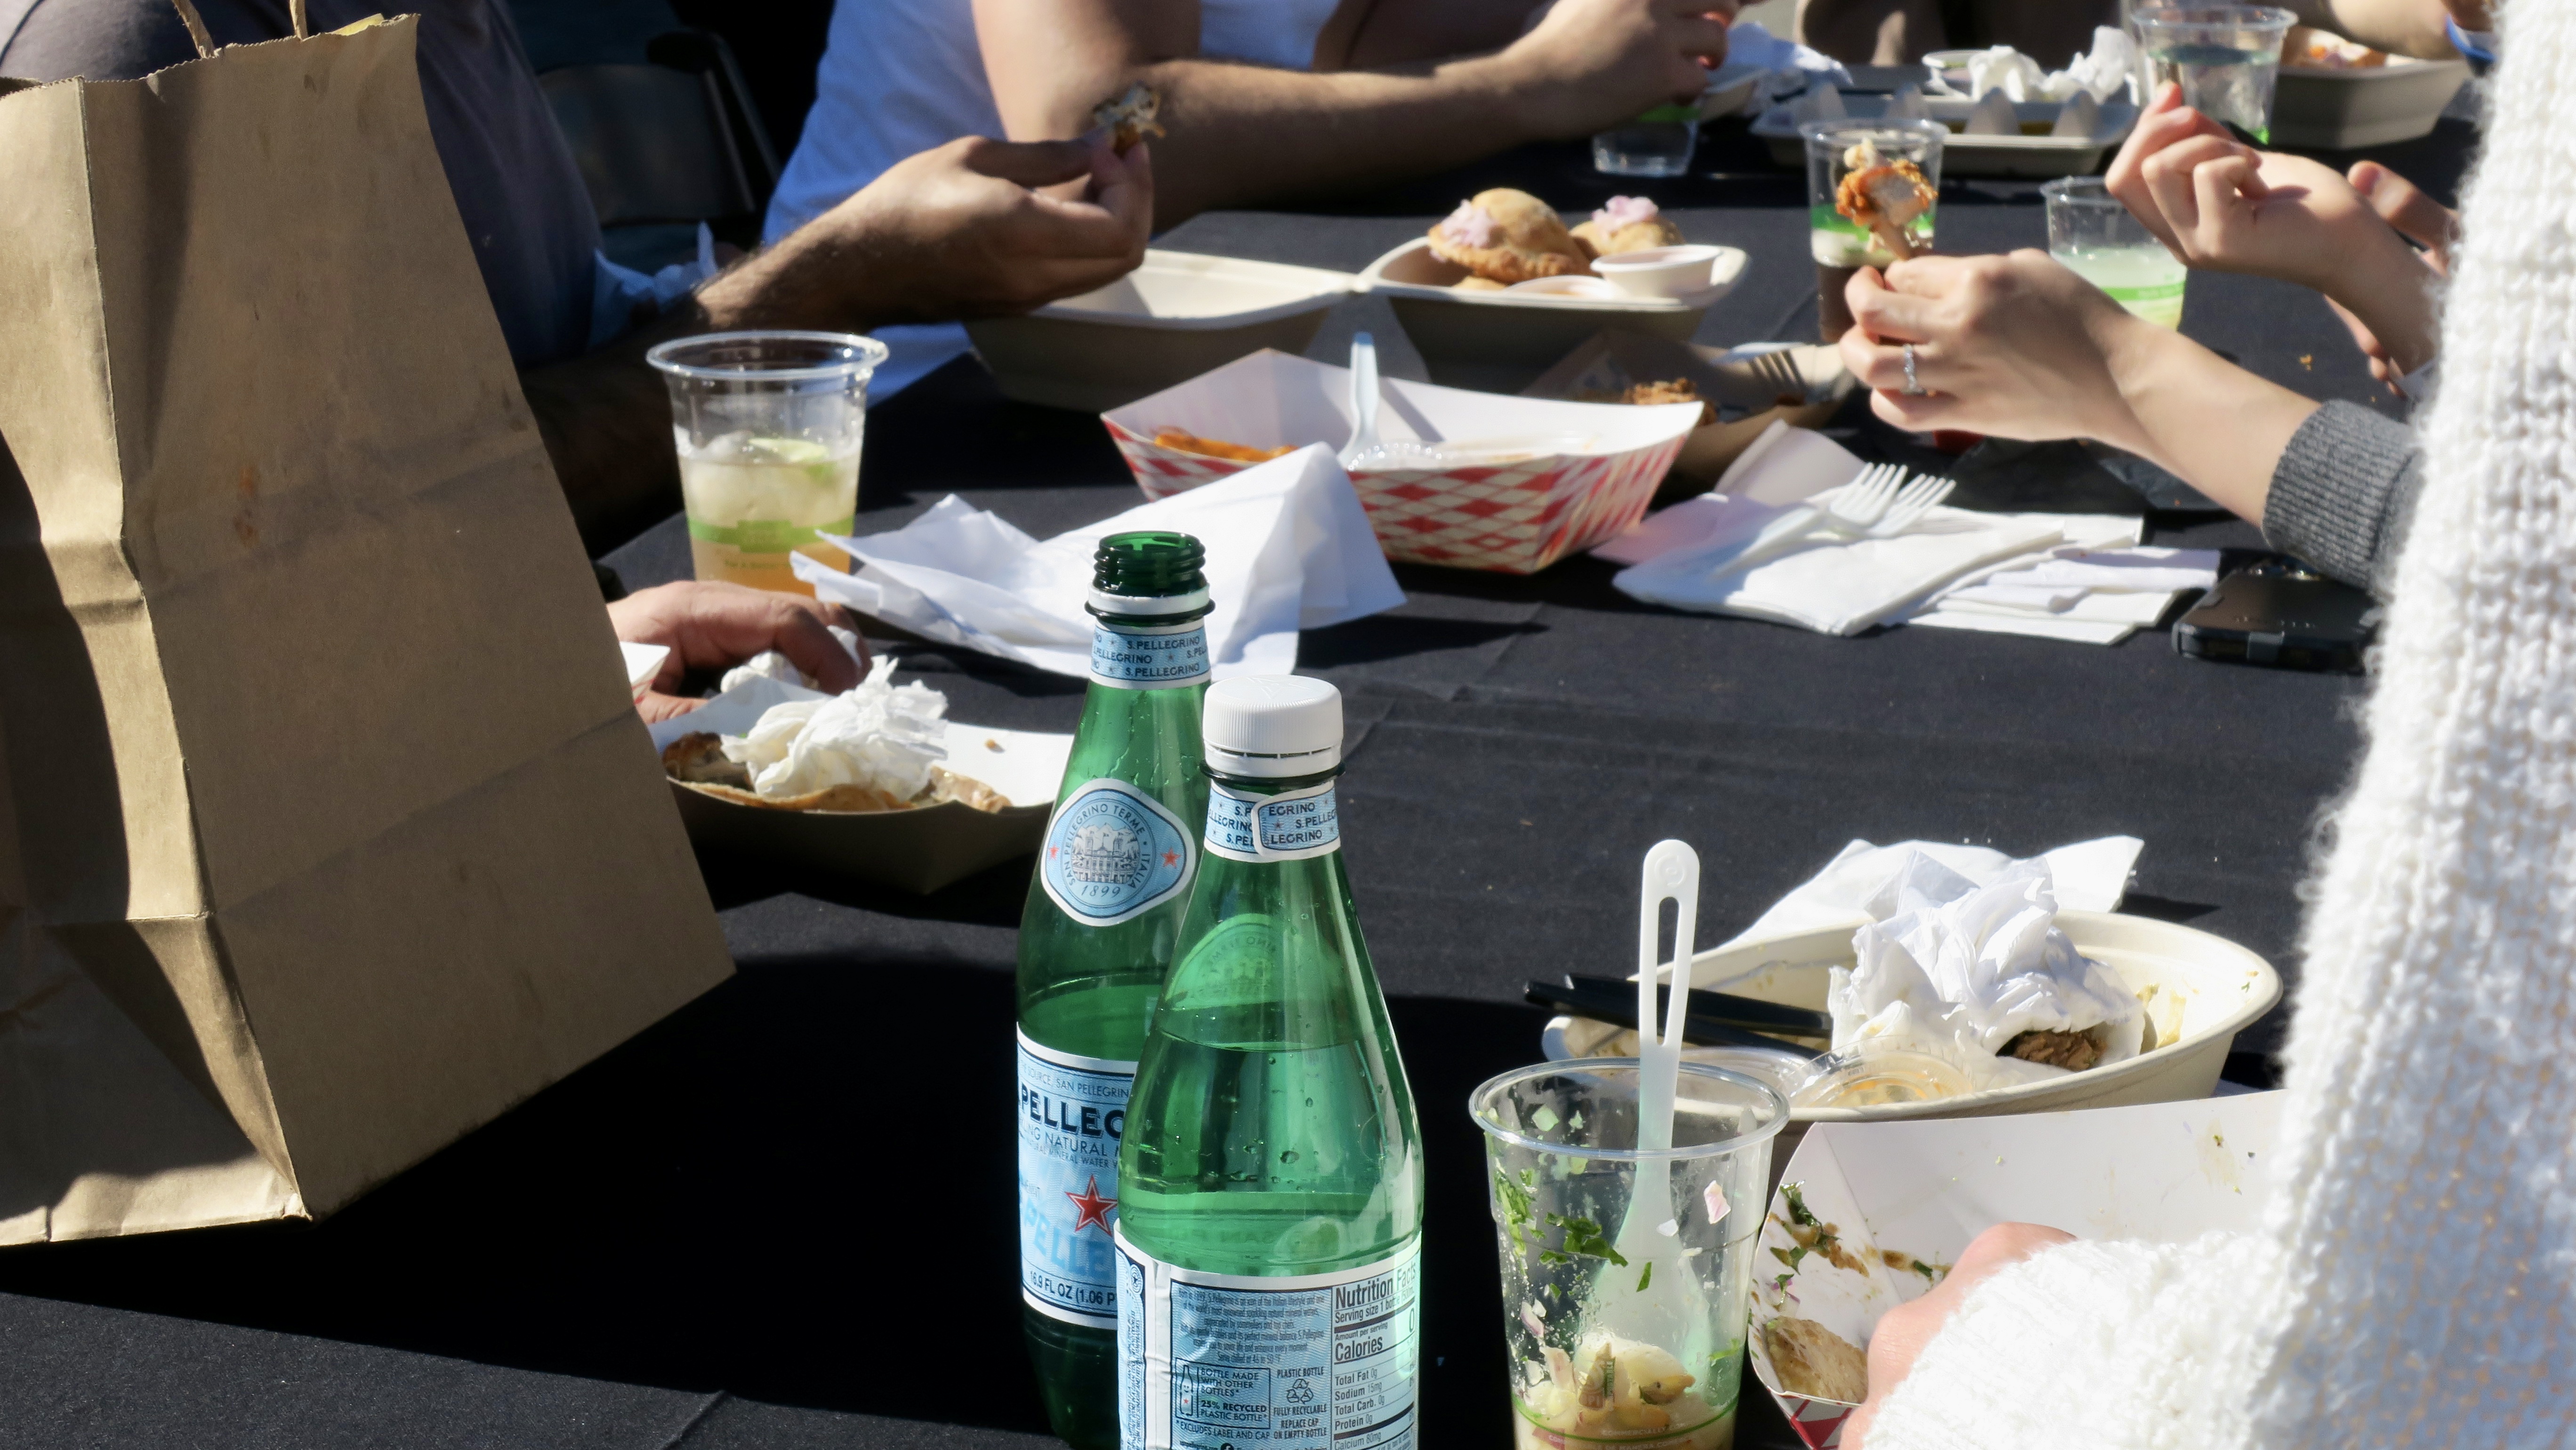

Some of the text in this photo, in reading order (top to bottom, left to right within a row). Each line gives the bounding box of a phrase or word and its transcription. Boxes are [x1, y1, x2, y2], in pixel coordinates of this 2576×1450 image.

[1127, 636, 1199, 650] S.PELLEGRINO
[1125, 663, 1199, 677] S.PELLEGRINO
[1064, 804, 1151, 889] SAN PELLEGRINO TERME ITALIA
[1081, 884, 1121, 898] 1899
[1056, 1078, 1075, 1091] SAN
[1078, 1083, 1129, 1098] PELLEGRIN
[1045, 1131, 1107, 1157] NATURAL
[1082, 1157, 1109, 1168] WATER
[1030, 1270, 1116, 1306] 16.9 FL OZ (1.06 P
[1336, 1261, 1416, 1309] Nutrition Facts
[1335, 1309, 1363, 1324] Serving
[1366, 1304, 1378, 1317] size
[1380, 1302, 1384, 1312] 1
[1335, 1322, 1388, 1342] Amount per serving
[1335, 1336, 1383, 1361] Calories
[1409, 1307, 1415, 1333] 0
[1201, 1368, 1260, 1380] BOTTLE MADE
[1277, 1366, 1324, 1378] PLASTIC BOTTLE
[1335, 1373, 1354, 1386] Total
[1357, 1370, 1369, 1381] Fat
[1201, 1377, 1254, 1389] WITH OTHER
[1335, 1387, 1365, 1401] Sodium
[1201, 1400, 1267, 1413] 25% RECYCLED
[1273, 1404, 1327, 1416] FULLY RECYCLABLE
[1335, 1403, 1354, 1416] Total
[1357, 1398, 1377, 1411] Carb.
[1201, 1409, 1231, 1420] PLASTIC
[1280, 1418, 1319, 1429] REPLACE CAP
[1335, 1416, 1363, 1431] Protein
[1214, 1428, 1234, 1439] LABEL
[1236, 1431, 1253, 1440] AND
[1255, 1431, 1271, 1440] CAP
[1284, 1429, 1305, 1439] EMPTY
[1306, 1427, 1327, 1437] BOTTLE
[1335, 1437, 1364, 1450] Calcium
